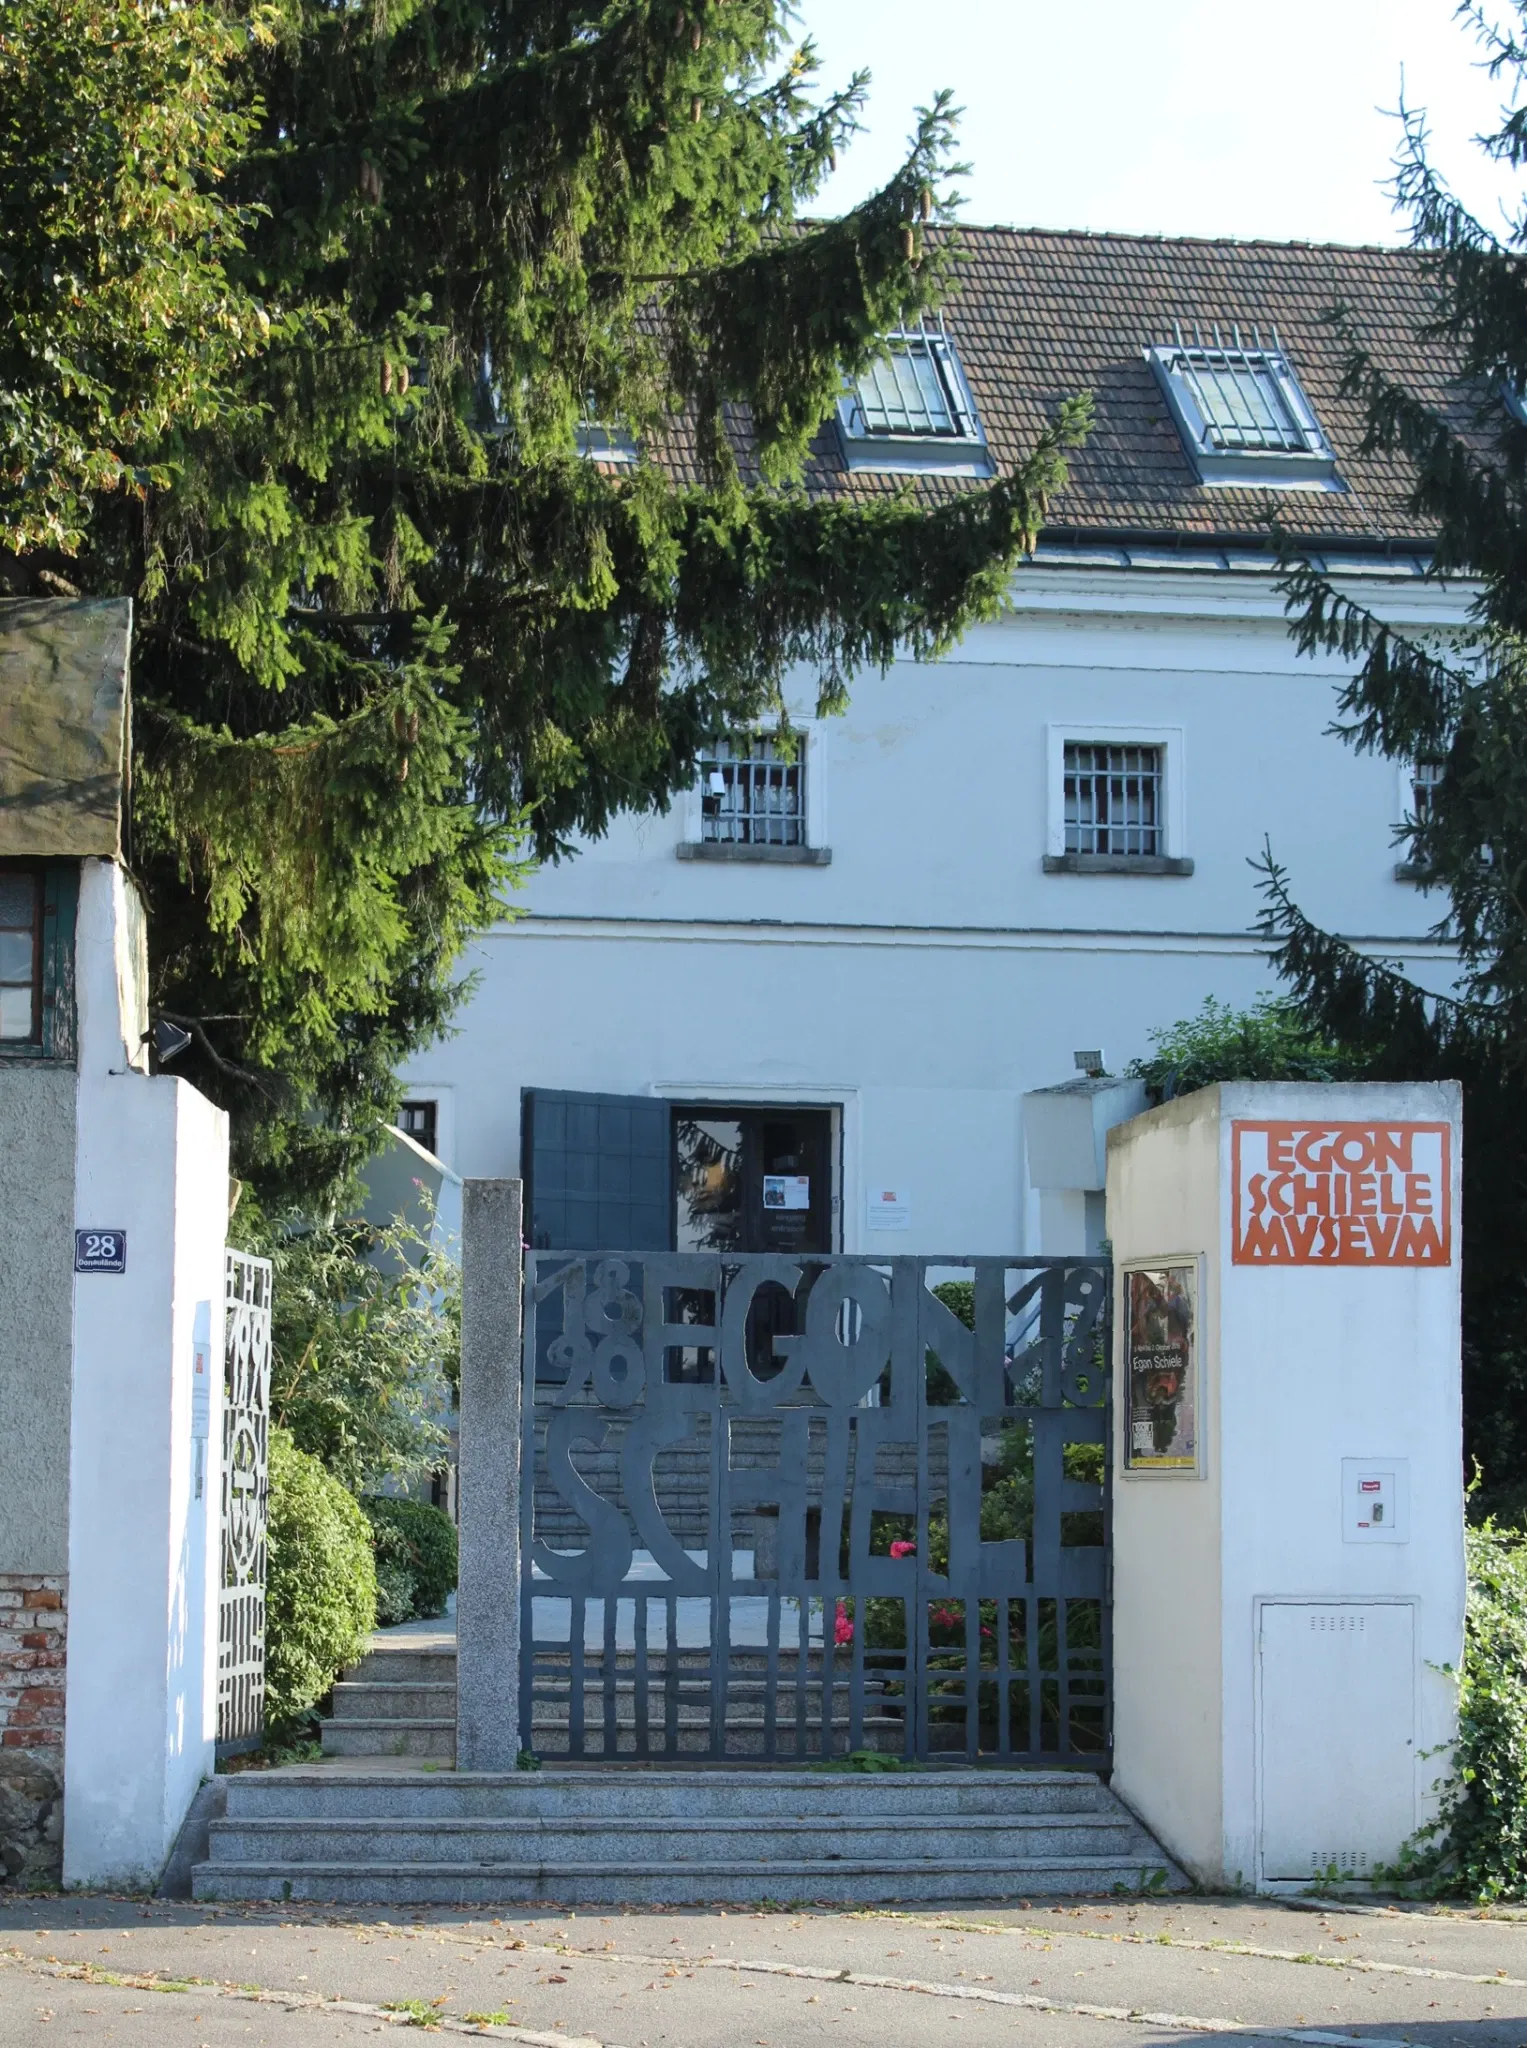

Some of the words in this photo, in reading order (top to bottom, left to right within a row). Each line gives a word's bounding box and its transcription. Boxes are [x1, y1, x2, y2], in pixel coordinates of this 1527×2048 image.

[1267, 1131, 1413, 1173] EGON
[1248, 1173, 1433, 1215] SCHIELE
[78, 1259, 122, 1267] Donaulände
[85, 1235, 116, 1257] 28
[641, 1258, 1006, 1412] EGON
[1132, 1356, 1153, 1372] Egon
[1153, 1354, 1183, 1369] Schiele
[532, 1408, 1106, 1584] SCHIELE
